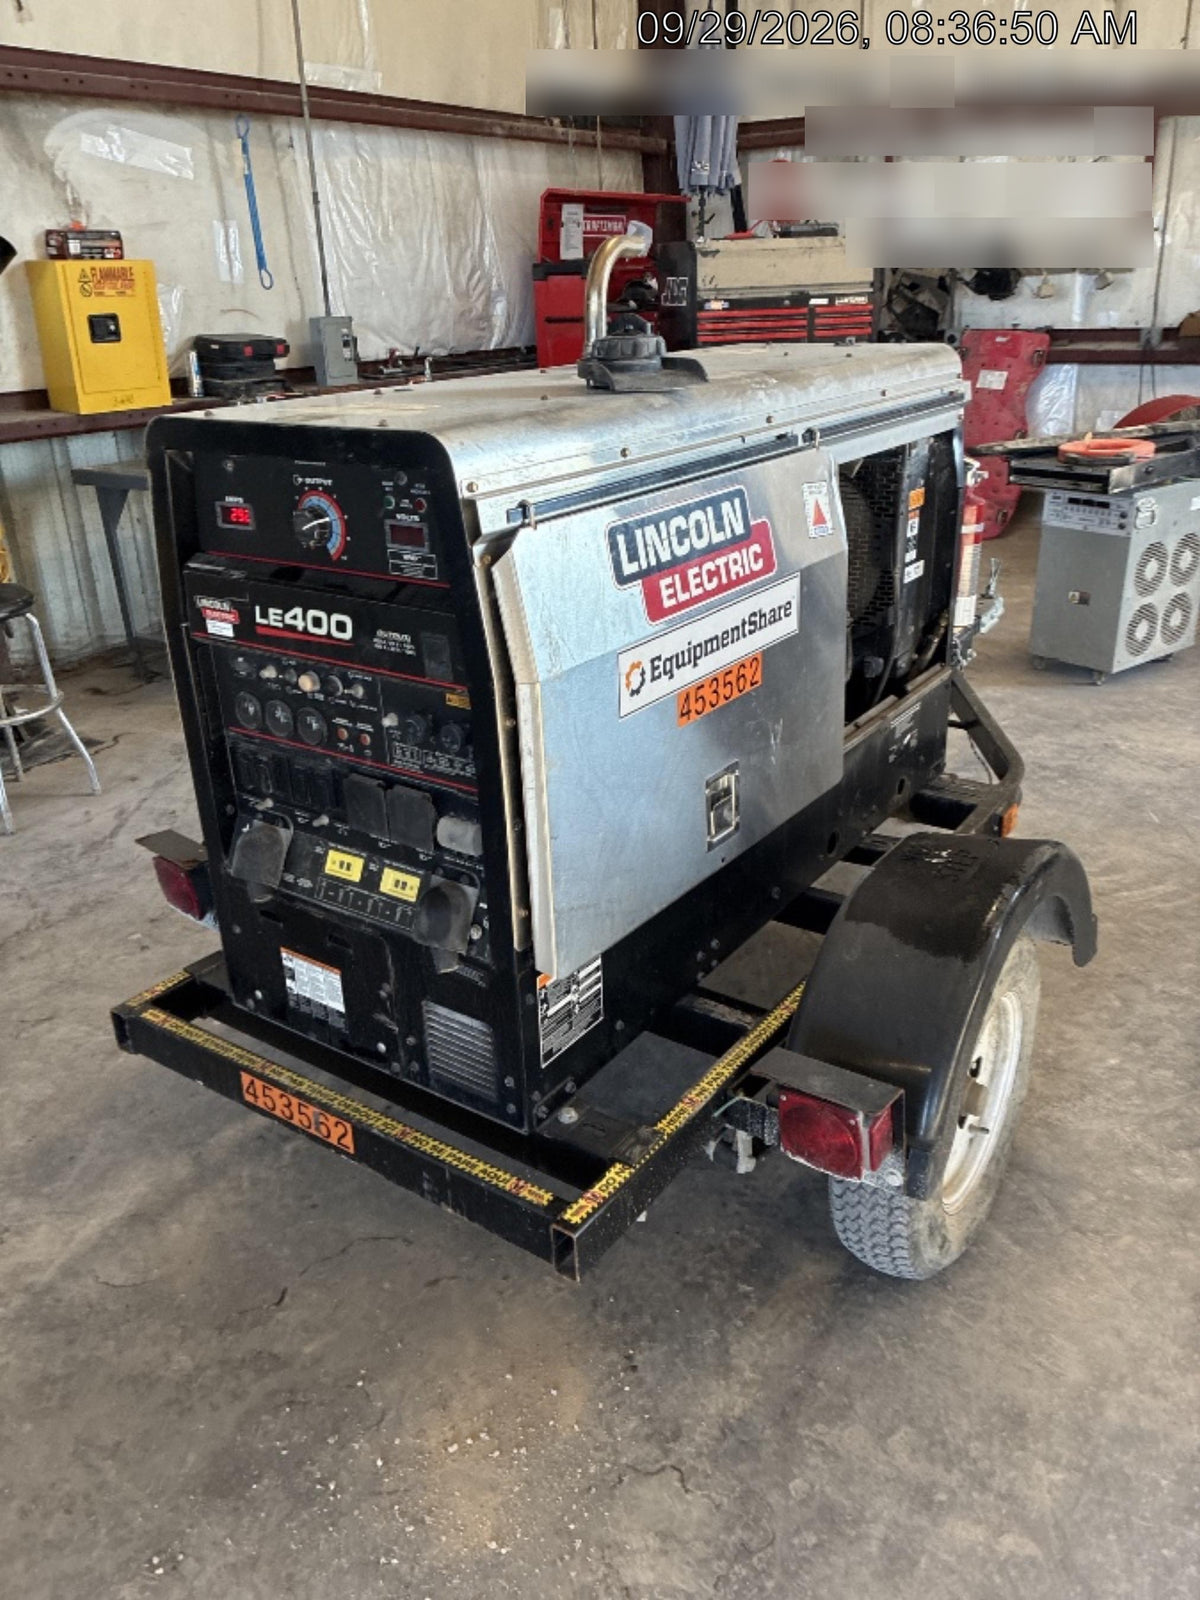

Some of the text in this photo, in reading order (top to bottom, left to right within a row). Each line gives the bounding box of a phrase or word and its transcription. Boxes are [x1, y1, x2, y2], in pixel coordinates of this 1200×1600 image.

[91, 266, 134, 281] FLAMMABLE
[616, 497, 746, 577] LINCOLN
[659, 543, 764, 609] ELECTRIC
[255, 605, 353, 641] LE400
[650, 600, 793, 683] EquipmentShare
[679, 656, 761, 721] 453562
[245, 1079, 350, 1150] 453562
[599, 1176, 616, 1192] DO
